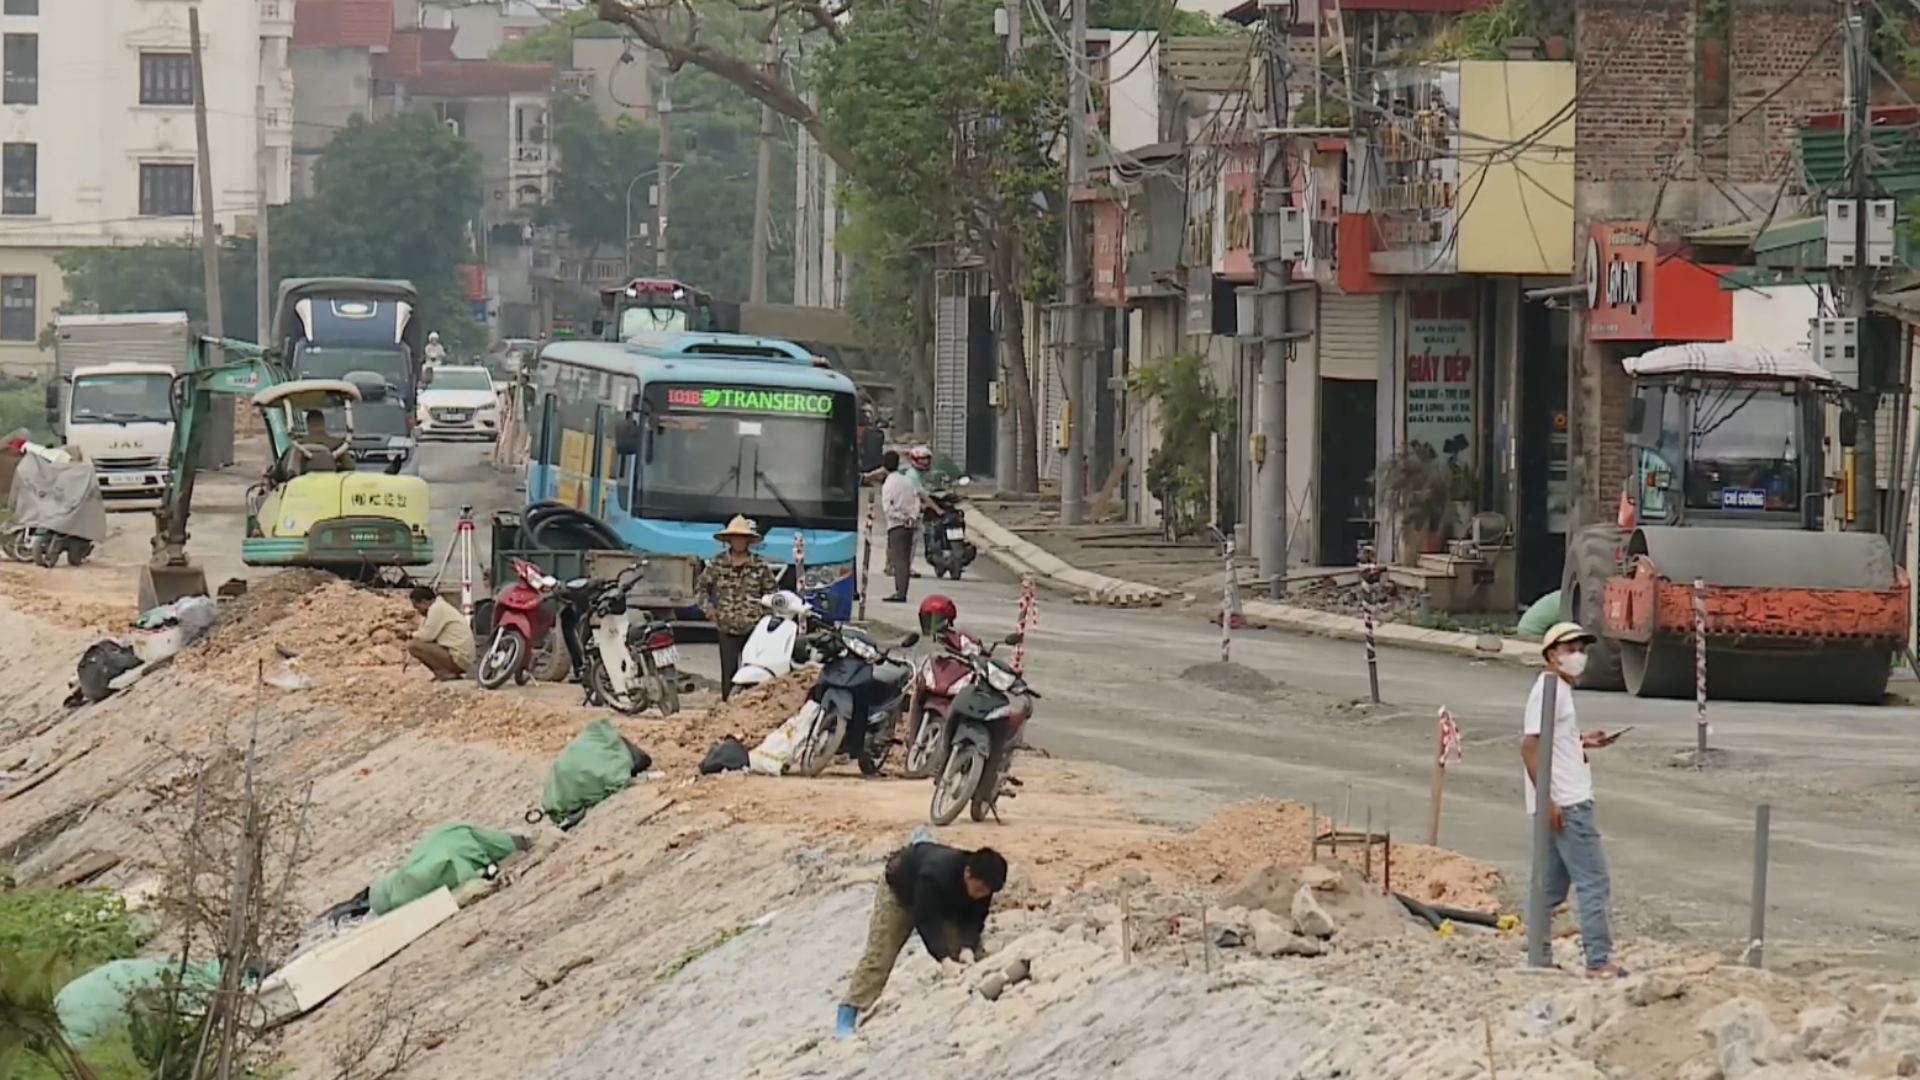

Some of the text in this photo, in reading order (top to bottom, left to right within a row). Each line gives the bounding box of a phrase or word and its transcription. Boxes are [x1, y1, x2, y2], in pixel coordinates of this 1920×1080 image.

[1443, 350, 1471, 382] DÉP
[722, 389, 833, 413] TRANSERCO
[1409, 388, 1426, 399] NAM
[1459, 388, 1471, 399] EM
